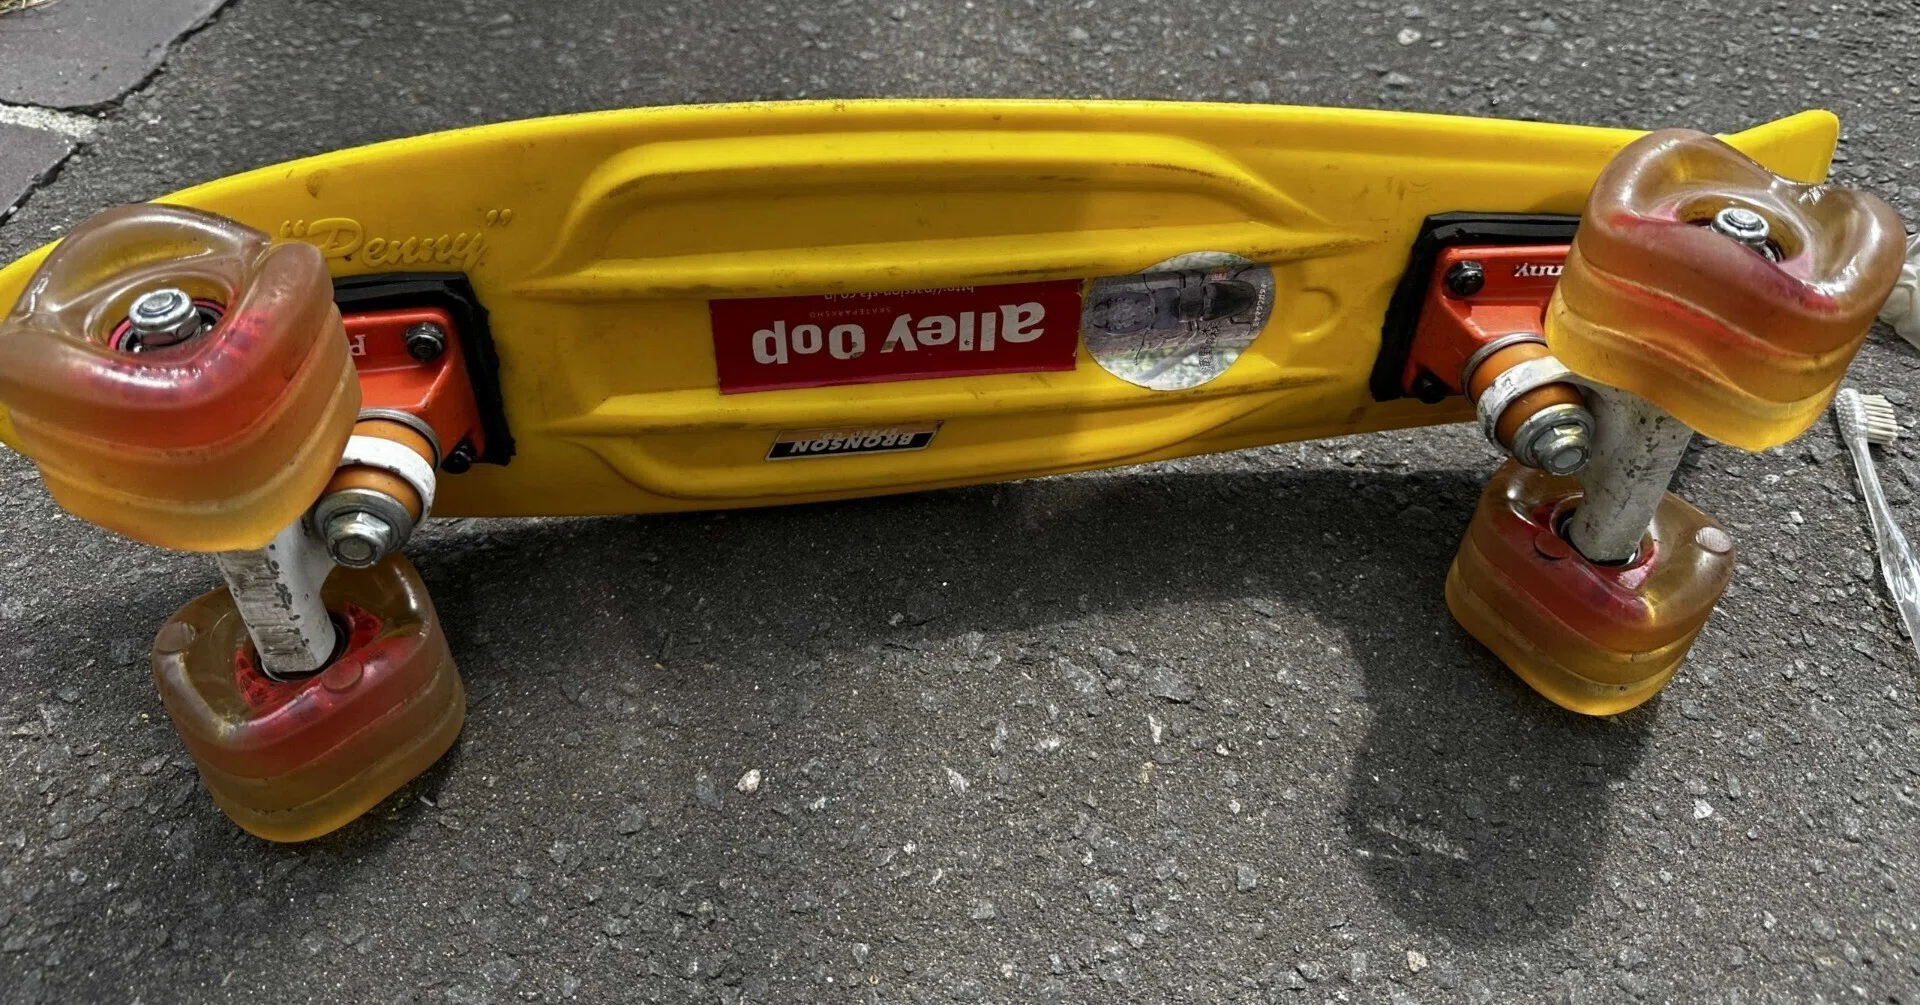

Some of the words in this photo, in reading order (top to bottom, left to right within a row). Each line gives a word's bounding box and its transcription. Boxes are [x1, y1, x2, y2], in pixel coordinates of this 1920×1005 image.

[1514, 262, 1564, 277] nny
[880, 301, 1046, 354] alley
[789, 432, 916, 453] BRONSON
